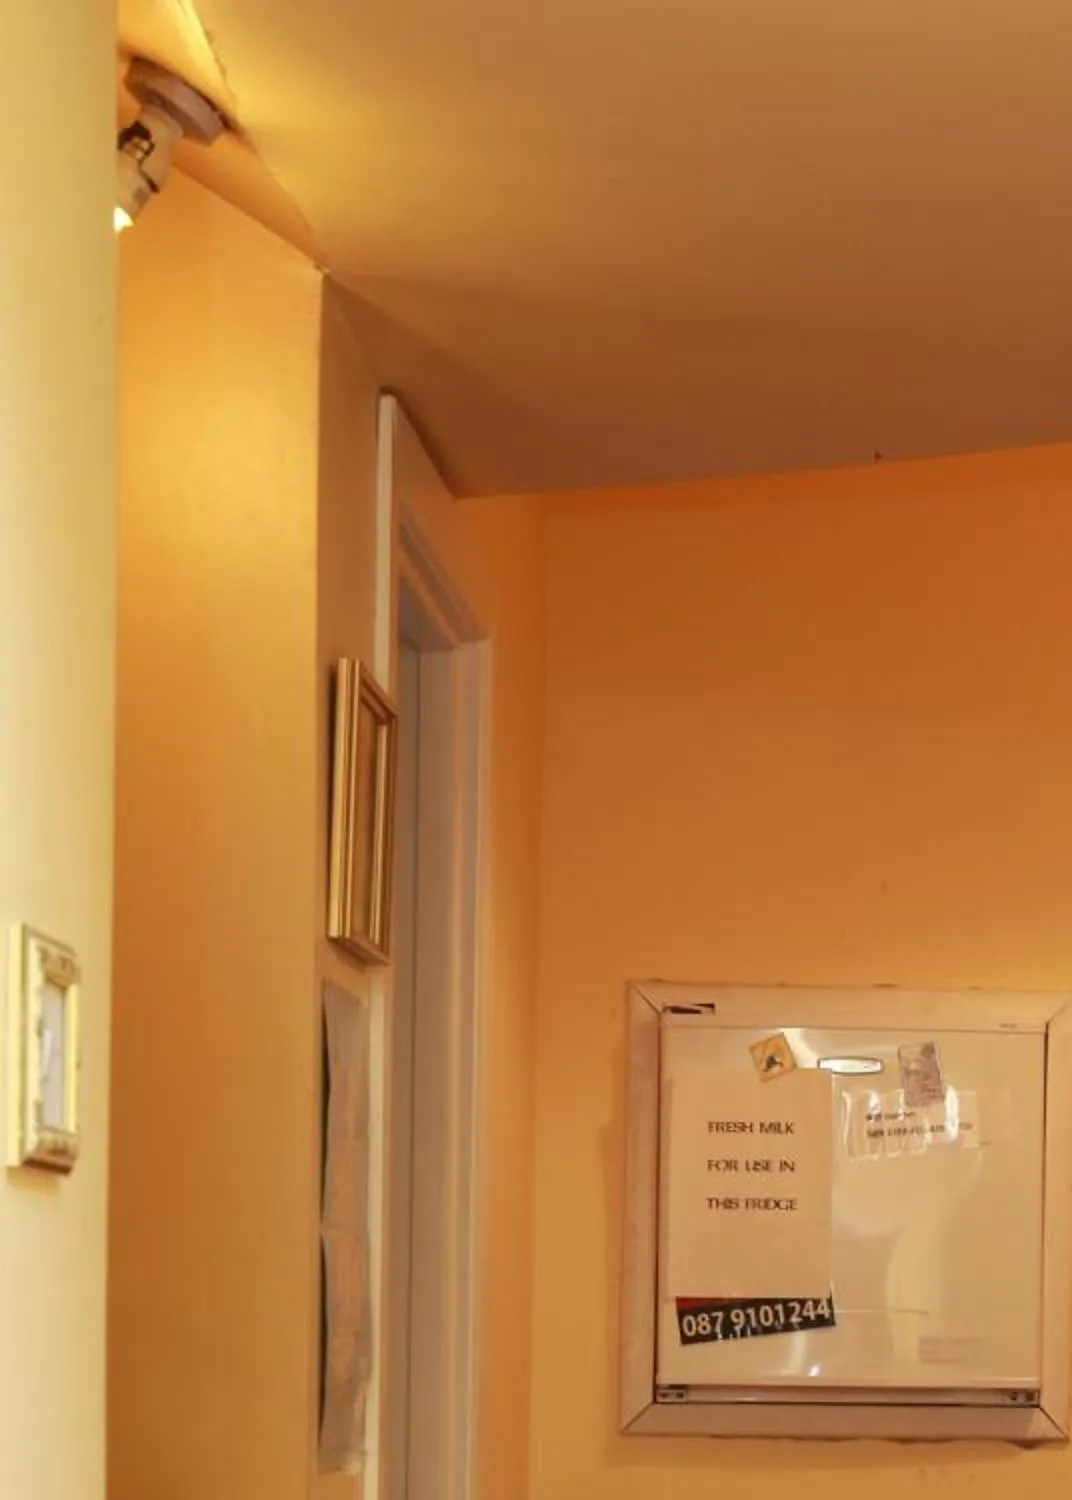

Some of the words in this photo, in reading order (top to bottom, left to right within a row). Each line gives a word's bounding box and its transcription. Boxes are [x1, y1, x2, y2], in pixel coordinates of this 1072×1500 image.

[707, 1121, 754, 1133] FRESH
[759, 1121, 795, 1134] MILK
[707, 1159, 739, 1172] FOR
[745, 1159, 771, 1172] USE
[779, 1159, 796, 1172] IN
[706, 1197, 740, 1210] THIS
[745, 1197, 798, 1211] FRIDGE
[682, 1311, 725, 1338] 087
[730, 1298, 831, 1328] 9101244
